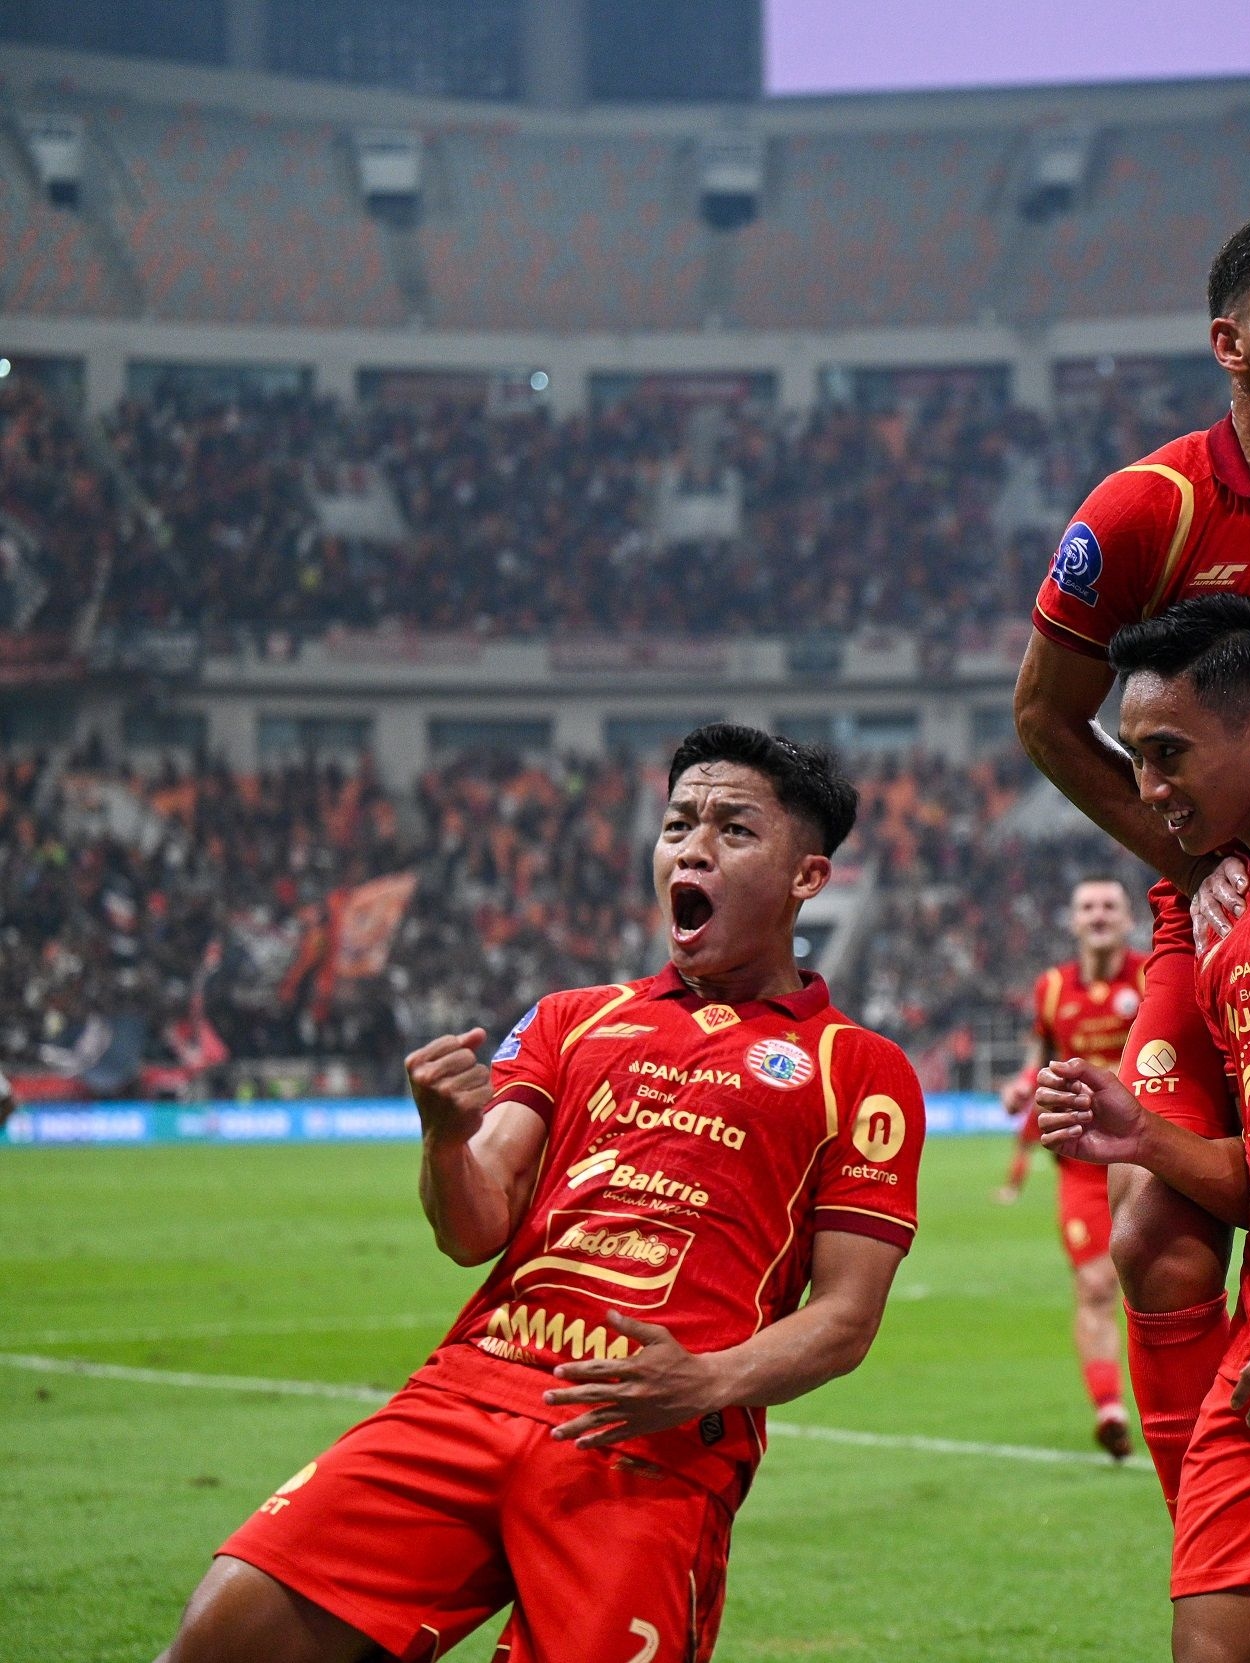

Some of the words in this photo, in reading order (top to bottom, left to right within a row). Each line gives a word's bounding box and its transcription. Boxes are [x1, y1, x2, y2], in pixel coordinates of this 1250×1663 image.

[636, 1084, 677, 1105] Bank
[1131, 1077, 1180, 1097] TCT
[615, 1099, 747, 1151] Jakarta
[608, 1164, 709, 1207] Bakrie
[841, 1164, 899, 1186] netzme
[476, 1335, 538, 1365] AMMAN
[260, 1496, 291, 1516] CT
